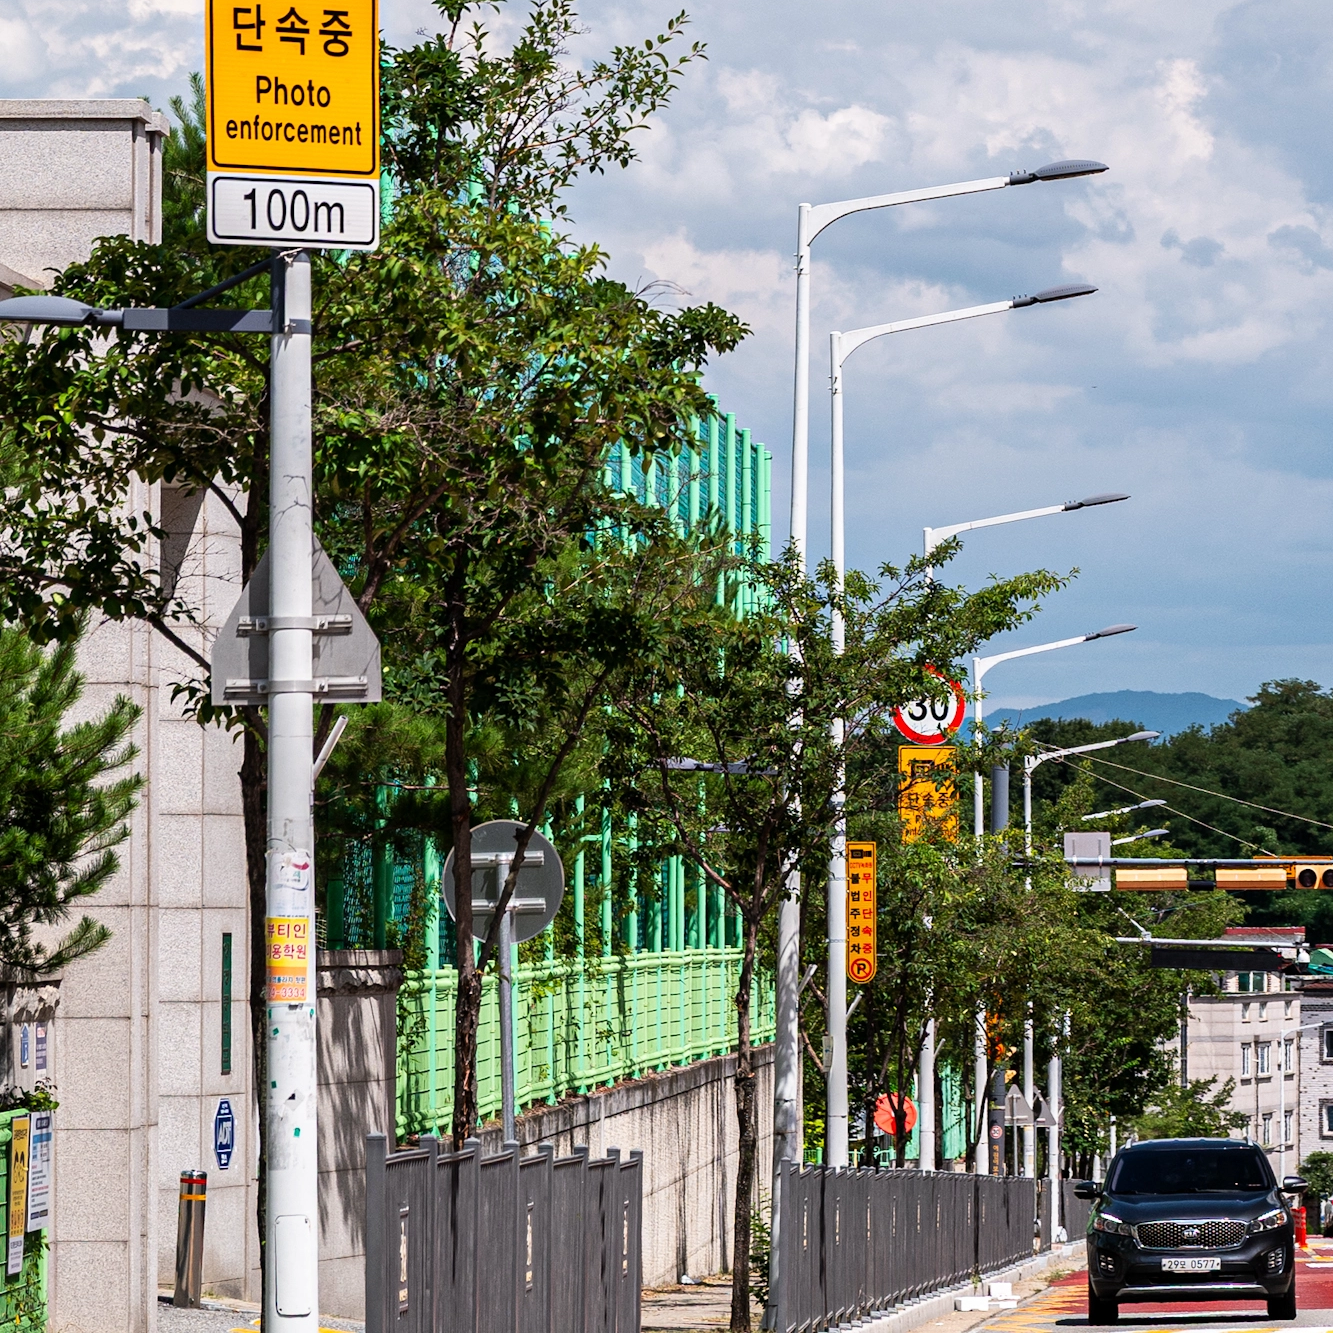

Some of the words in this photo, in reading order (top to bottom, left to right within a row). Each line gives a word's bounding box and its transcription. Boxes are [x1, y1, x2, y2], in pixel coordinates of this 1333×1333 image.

[233, 3, 353, 58] 단속중
[256, 75, 331, 108] Photo
[226, 114, 362, 146] enforcement
[243, 188, 345, 235] 100m
[1190, 1259, 1215, 1269] 0577
